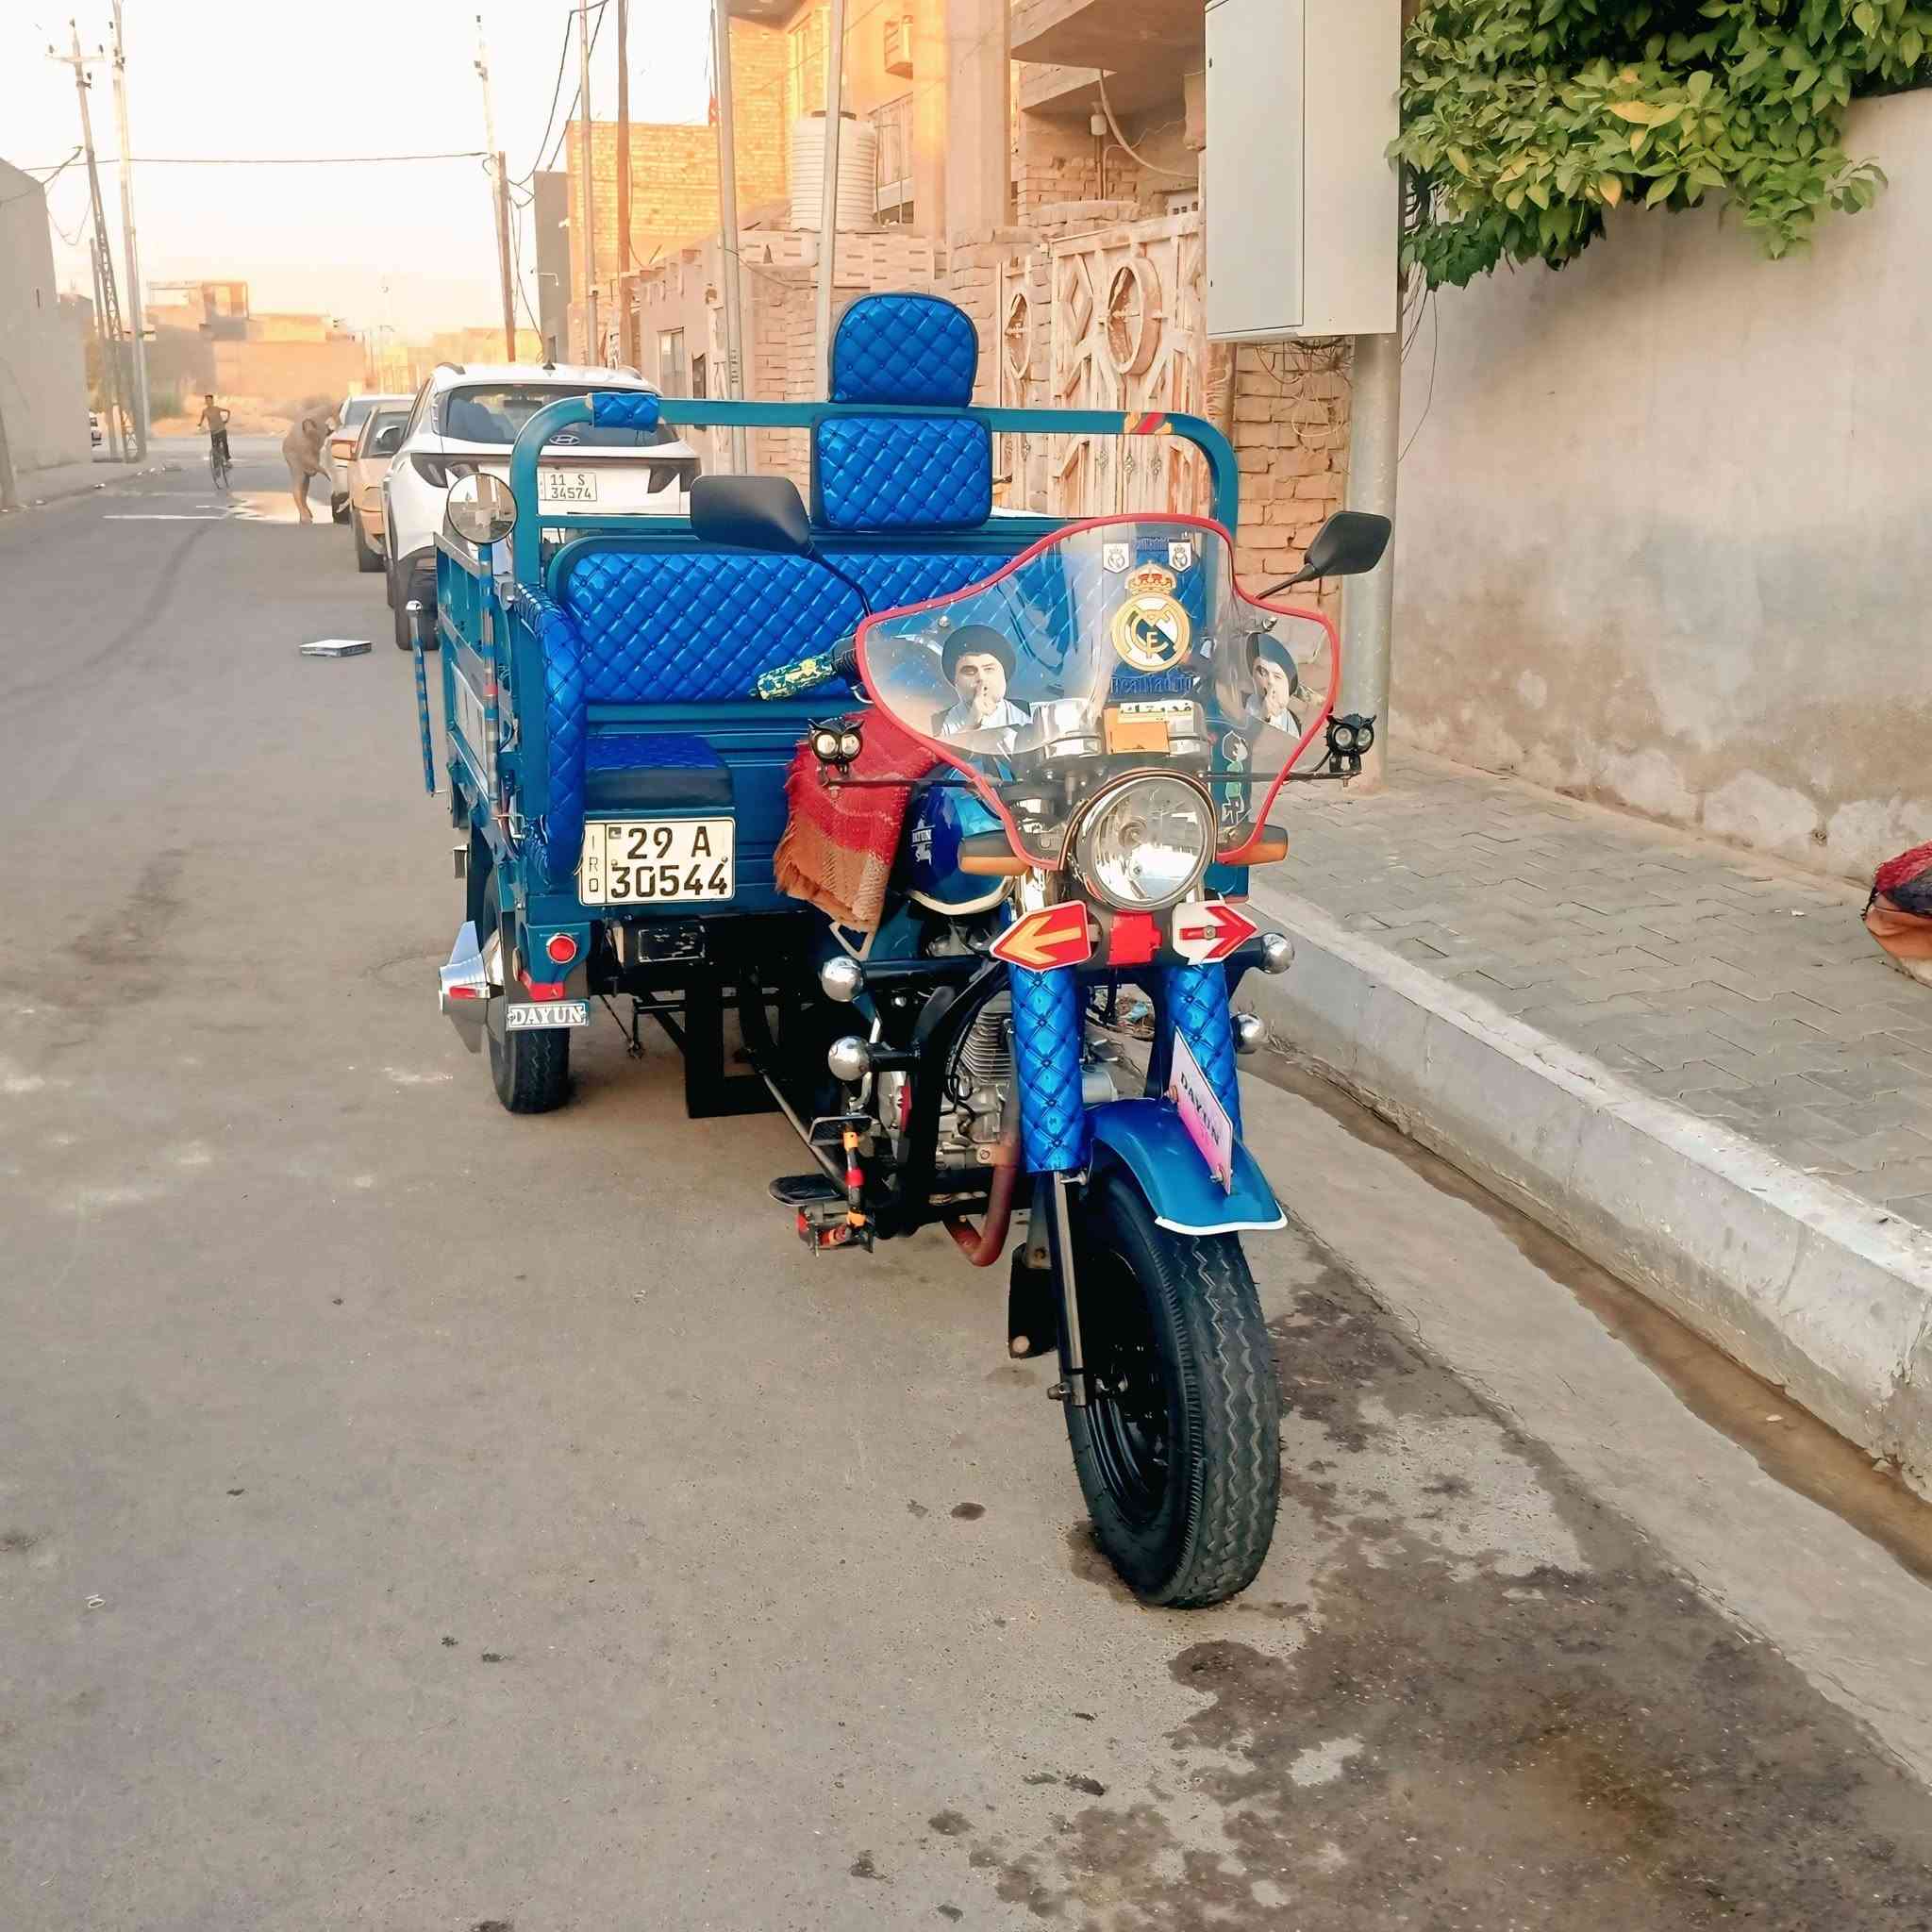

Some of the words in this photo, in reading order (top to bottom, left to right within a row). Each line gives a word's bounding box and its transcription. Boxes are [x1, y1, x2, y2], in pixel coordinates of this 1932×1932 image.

[550, 474, 566, 486] 11
[577, 474, 585, 486] S
[551, 487, 591, 499] 34574
[627, 826, 673, 859] 29
[691, 825, 711, 858] A
[610, 863, 727, 898] 30544
[510, 1006, 583, 1025] DAYUN
[1180, 1071, 1221, 1146] DAYUN
